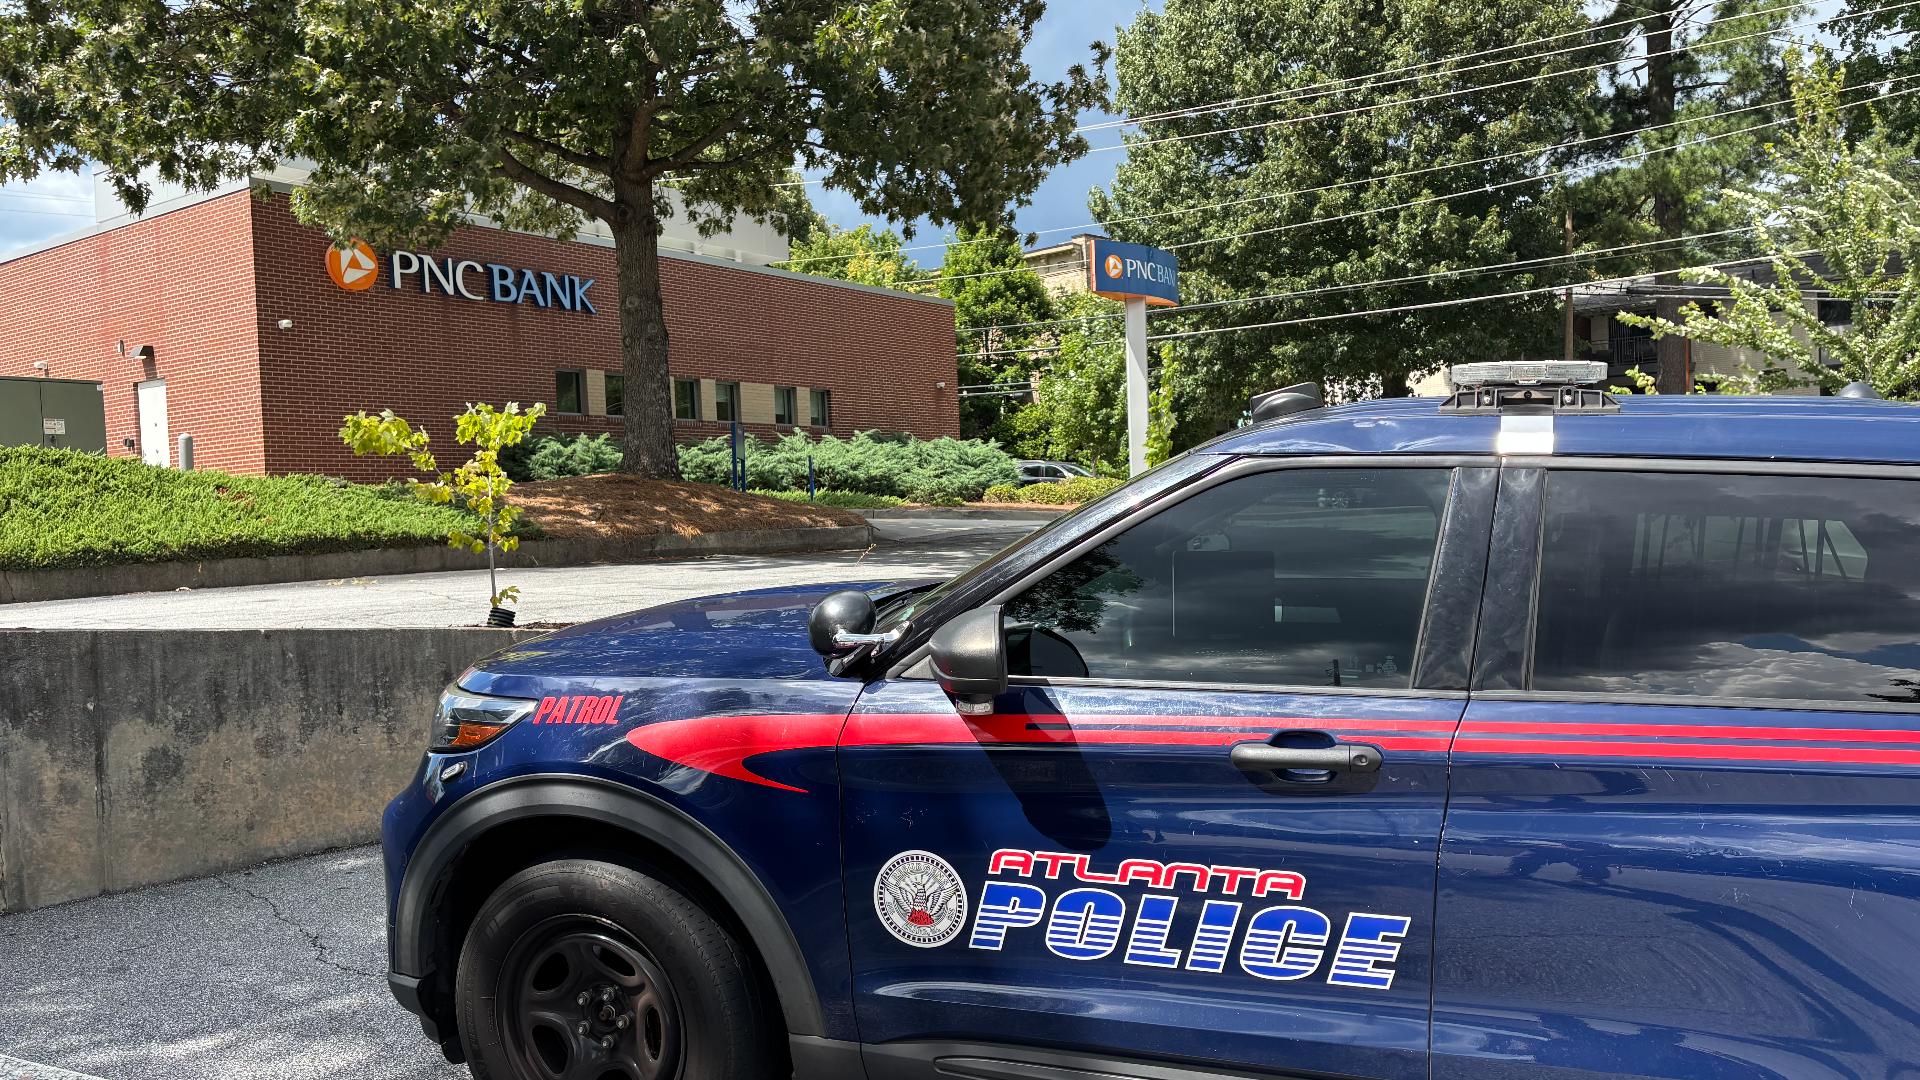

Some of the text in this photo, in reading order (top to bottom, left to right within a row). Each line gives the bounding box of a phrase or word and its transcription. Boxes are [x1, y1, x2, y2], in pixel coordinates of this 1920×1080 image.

[391, 250, 597, 314] PNC BANK
[1125, 259, 1176, 287] PNC BAN
[532, 695, 624, 725] PATROL
[987, 848, 1307, 900] ATLANTA
[968, 880, 1412, 990] POLICE
